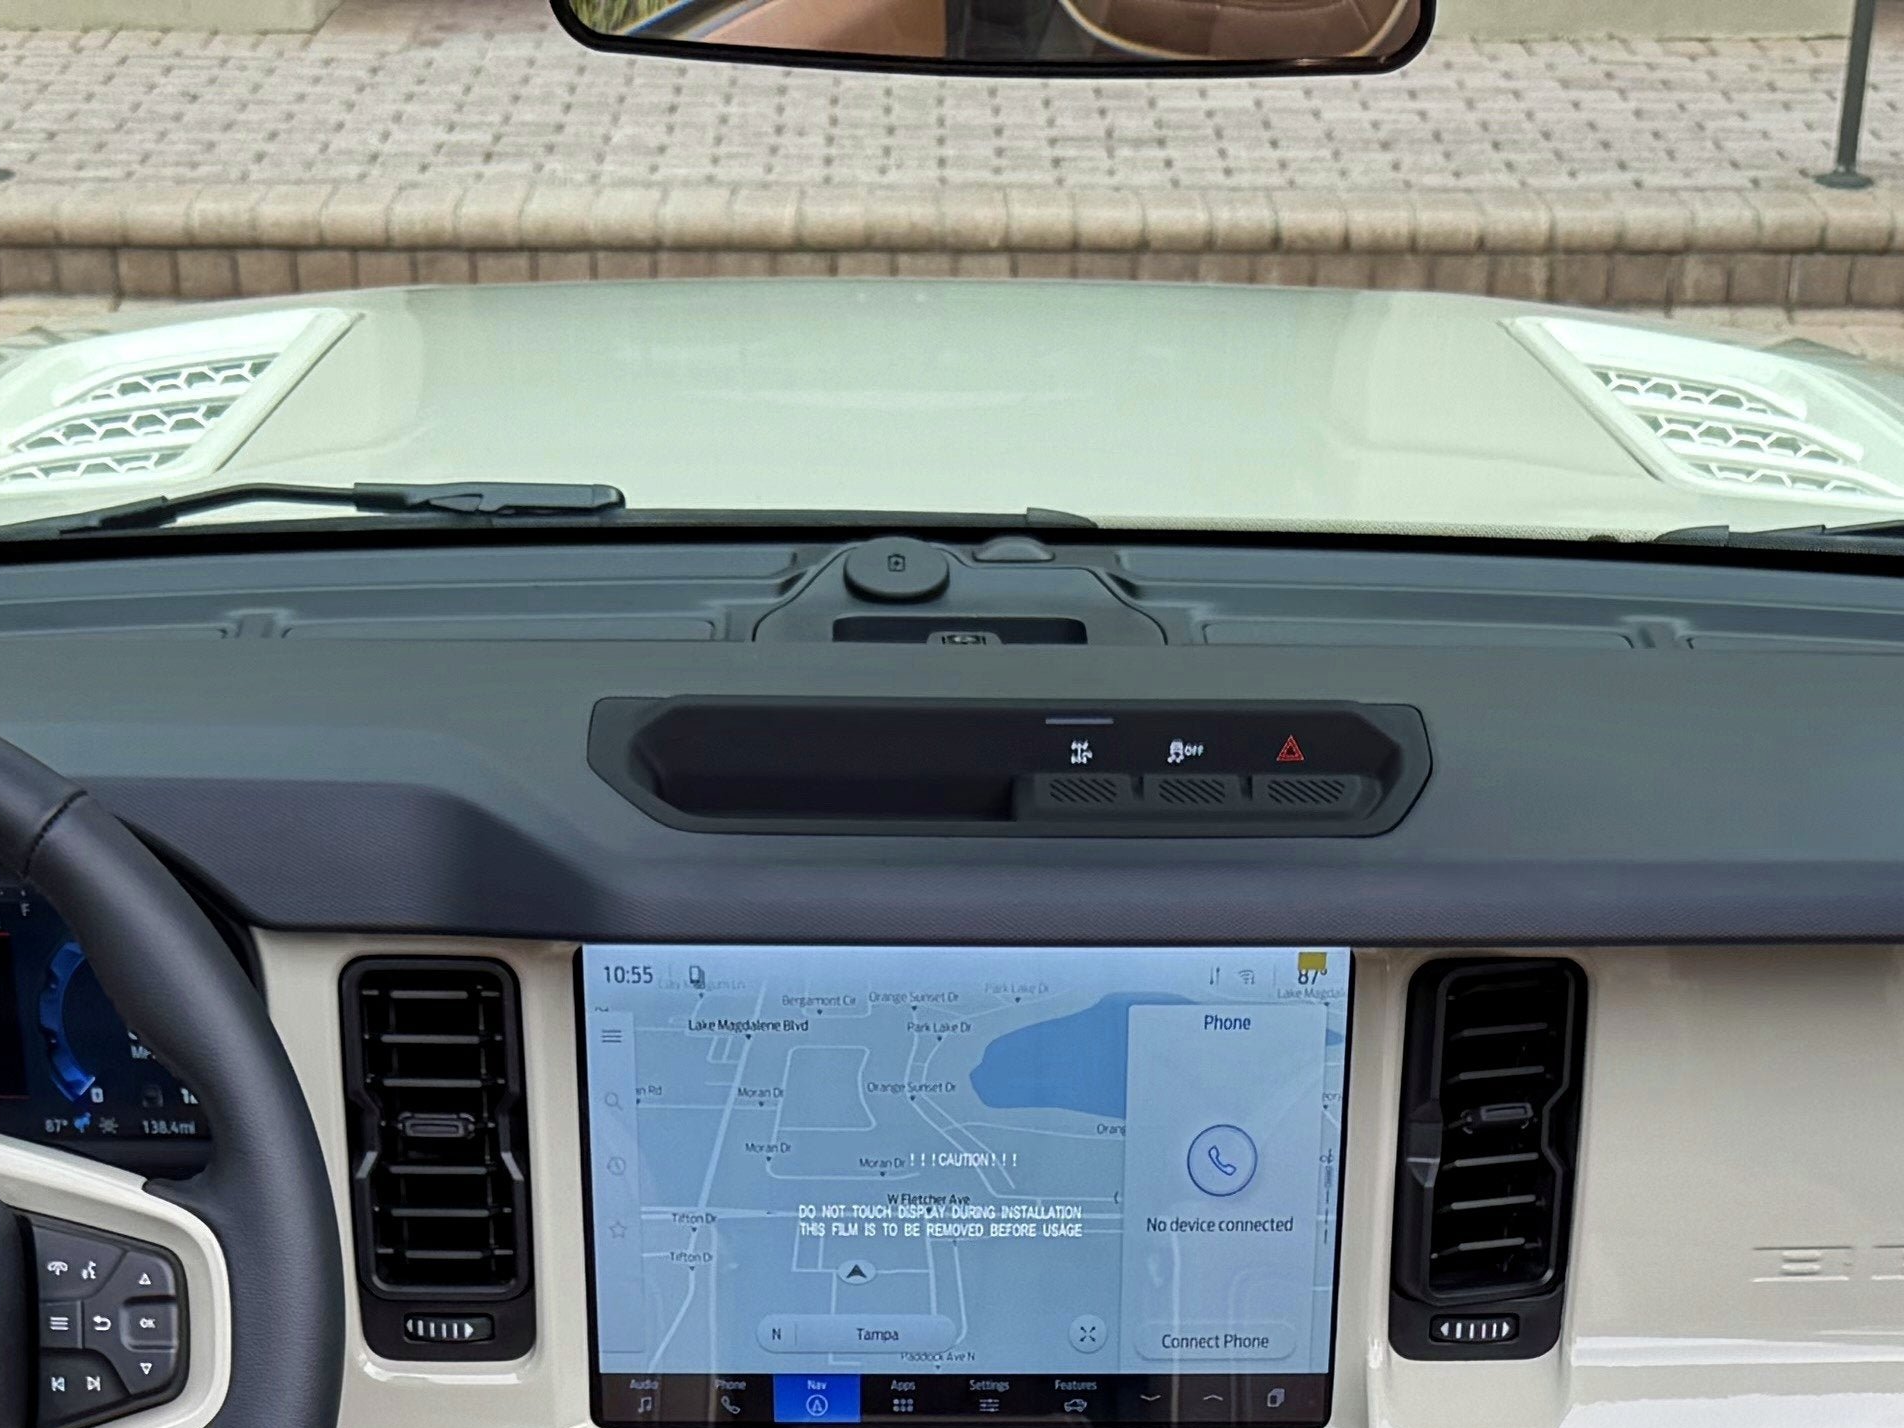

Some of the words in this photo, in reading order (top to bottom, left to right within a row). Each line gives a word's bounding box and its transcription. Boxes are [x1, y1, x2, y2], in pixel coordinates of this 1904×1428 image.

[21, 904, 30, 916] F
[603, 966, 654, 985] 10:55
[869, 992, 907, 1004] Orange
[910, 992, 946, 1003] Sunset
[948, 992, 960, 1001] Dr
[688, 1020, 716, 1032] Lake
[718, 1020, 781, 1034] Magdalene
[783, 1020, 809, 1032] Blvd
[907, 1022, 931, 1033] Park
[933, 1022, 959, 1033] Lake
[961, 1022, 972, 1032] Dr
[1203, 1014, 1252, 1031] Phone
[648, 1085, 662, 1096] Rd
[738, 1088, 771, 1098] Moran
[867, 1083, 906, 1095] Orange
[907, 1082, 944, 1093] Sunset
[946, 1082, 957, 1092] Dr
[745, 1143, 780, 1153] Moran
[781, 1143, 792, 1153] Dr
[859, 1158, 892, 1169] Moran
[893, 1158, 906, 1168] Dr
[887, 1194, 899, 1205] W
[901, 1193, 946, 1206] Fletcher
[948, 1194, 971, 1205] Ave
[798, 1204, 816, 1218] DO
[822, 1205, 846, 1219] NOT
[852, 1205, 892, 1219] TOUCH
[898, 1205, 946, 1219] DISPLAY
[952, 1205, 996, 1219] DURING
[1001, 1205, 1083, 1219] INSTALLATION
[799, 1223, 826, 1237] THIS
[831, 1223, 859, 1237] FILM
[864, 1223, 876, 1236] IS
[883, 1223, 897, 1237] TO
[904, 1223, 921, 1237] BE
[926, 1223, 984, 1237] REMOVED
[990, 1223, 1037, 1237] BEFORE
[1042, 1223, 1083, 1237] USAGE
[1147, 1217, 1167, 1232] No
[1170, 1217, 1215, 1232] device
[1218, 1217, 1294, 1232] connected
[139, 1318, 156, 1329] OK
[772, 1328, 781, 1340] N
[856, 1328, 899, 1342] Tampa
[1161, 1334, 1219, 1349] Connect
[1223, 1334, 1269, 1349] Phone
[946, 1353, 965, 1362] Ave
[629, 1379, 658, 1390] Audio
[714, 1379, 746, 1390] Phone
[807, 1380, 827, 1390] Nav
[890, 1379, 916, 1392] Apps
[969, 1379, 1010, 1392] Settings
[1054, 1379, 1098, 1391] Features
